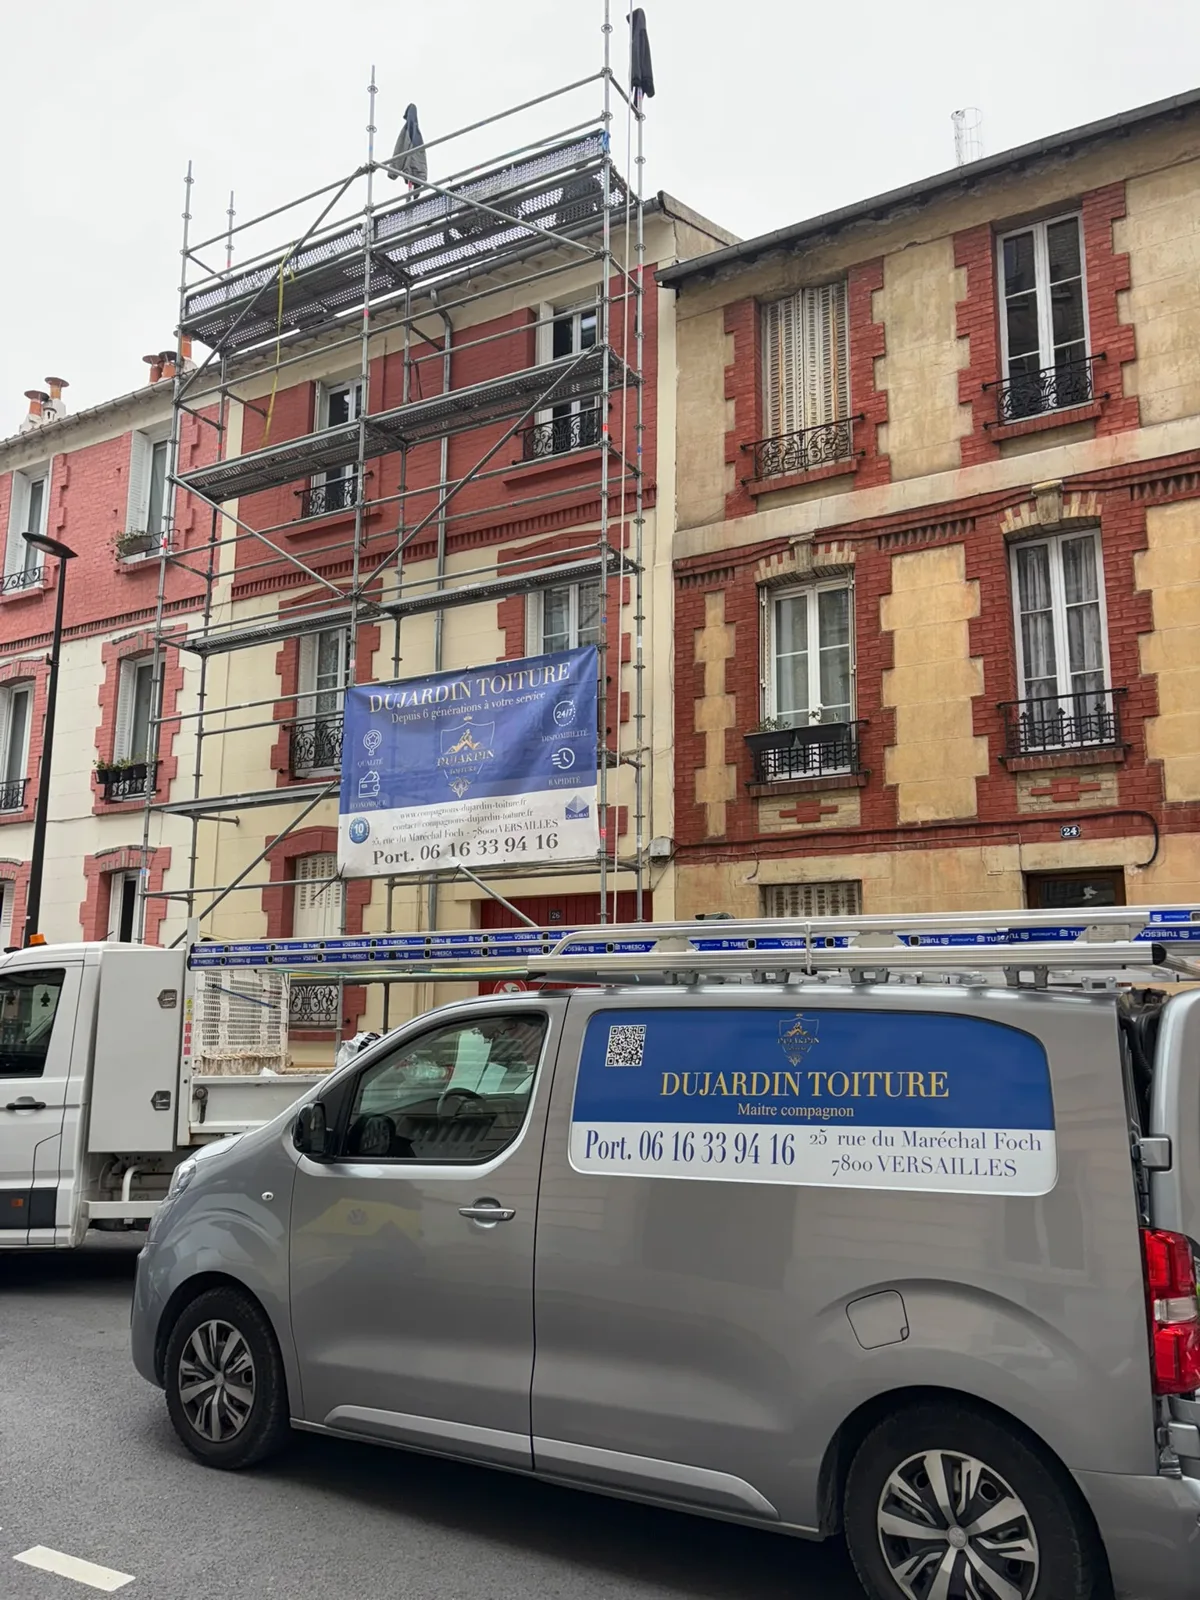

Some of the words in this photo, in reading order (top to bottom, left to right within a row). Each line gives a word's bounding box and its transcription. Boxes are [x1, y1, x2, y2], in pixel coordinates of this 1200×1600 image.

[368, 679, 473, 713] DUJARDIN
[475, 661, 571, 696] TOITURE
[391, 712, 421, 724] Depuis
[423, 708, 429, 719] 6
[431, 703, 482, 719] générations
[484, 700, 490, 709] à
[491, 697, 513, 708] votre
[514, 691, 546, 704] service
[556, 708, 573, 719] 24/7
[354, 823, 364, 834] 10
[408, 830, 442, 841] Maréchal
[444, 828, 464, 838] Foch
[498, 819, 559, 835] VERSAILLES
[373, 848, 415, 865] Port.
[420, 844, 441, 860] 06
[449, 841, 471, 858] 16
[476, 839, 499, 855] 33
[504, 835, 527, 853] 94
[535, 832, 559, 850] 16
[660, 1071, 802, 1096] DUJARDIN
[808, 1071, 949, 1097] TOITURE
[737, 1102, 778, 1116] Maitre
[781, 1105, 854, 1120] compagnon
[584, 1130, 632, 1160] Port.
[639, 1130, 664, 1161] 06
[672, 1131, 695, 1162] 16
[701, 1131, 727, 1163] 33
[734, 1132, 761, 1164] 94
[770, 1133, 796, 1165] 16
[809, 1129, 828, 1145] 25
[838, 1134, 866, 1146] rue
[872, 1130, 894, 1147] du
[901, 1130, 986, 1150] Maréchal
[993, 1132, 1042, 1151] Foch
[832, 1154, 873, 1177] 7800
[877, 1155, 1017, 1178] VERSAILLES
